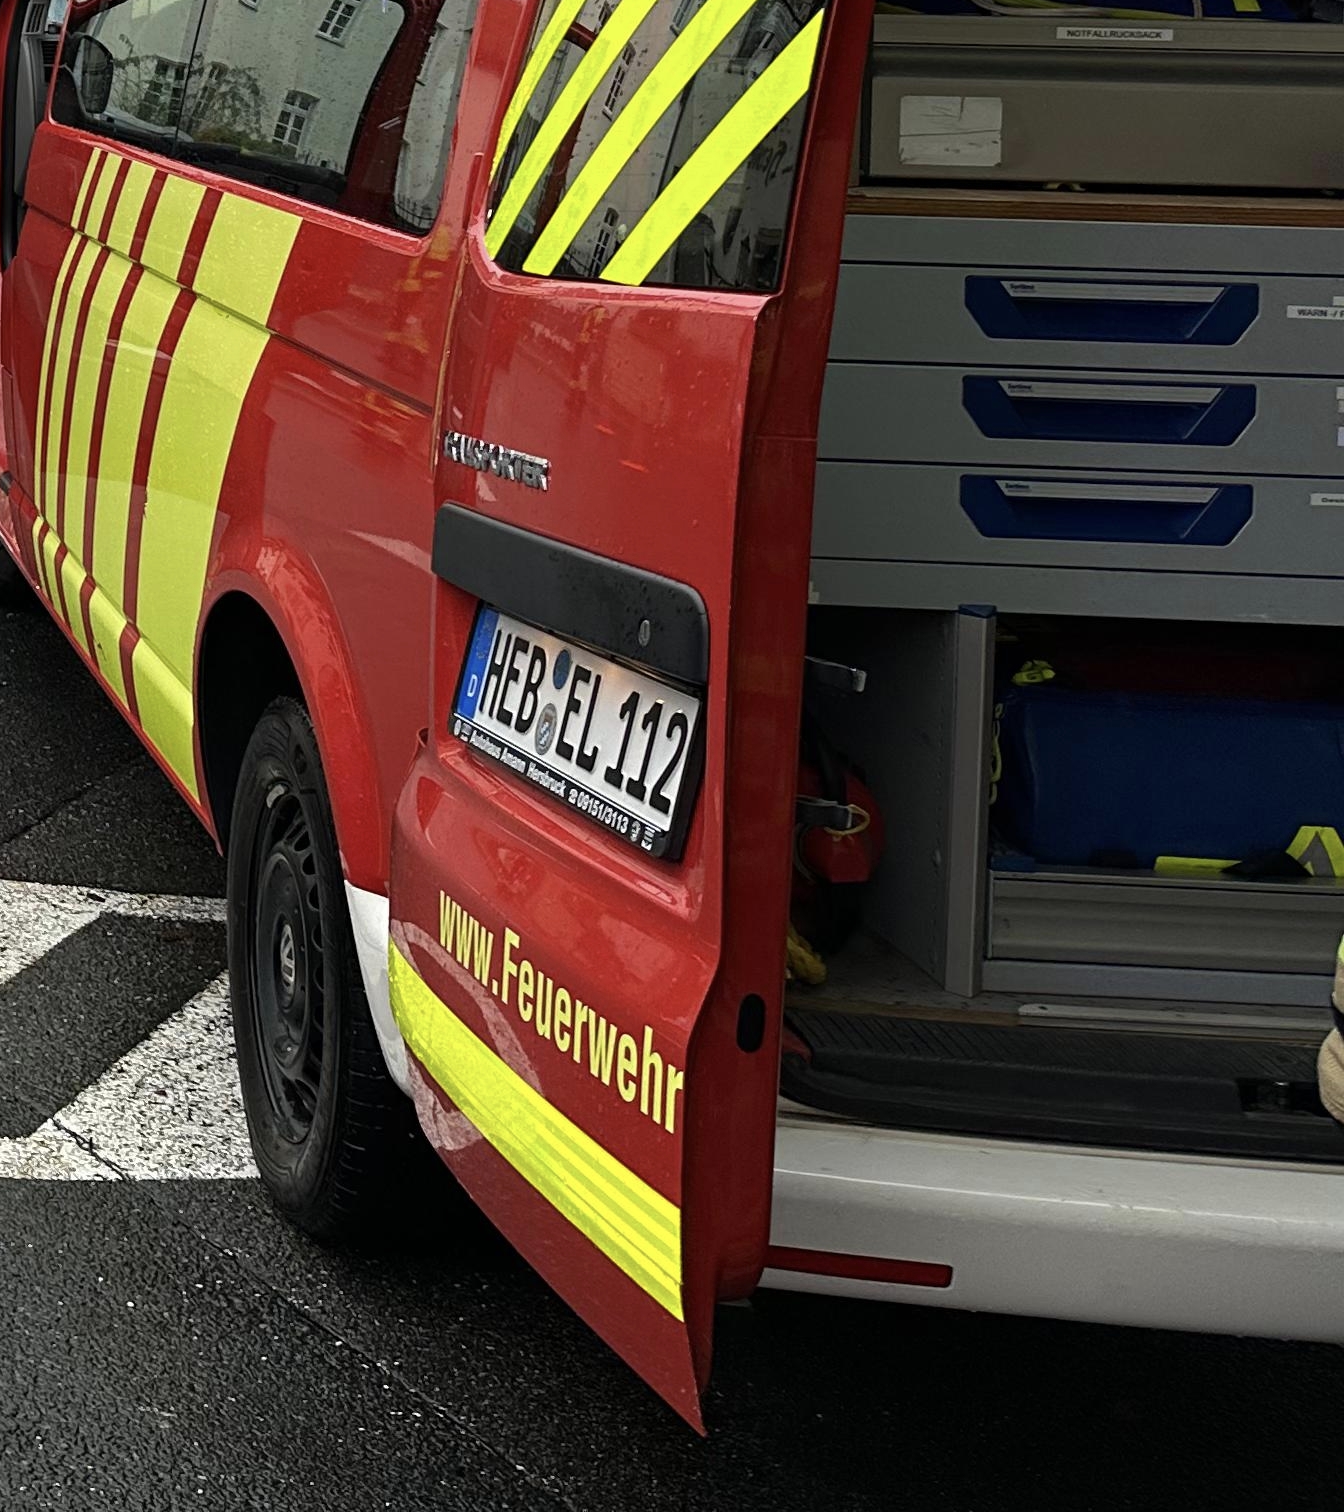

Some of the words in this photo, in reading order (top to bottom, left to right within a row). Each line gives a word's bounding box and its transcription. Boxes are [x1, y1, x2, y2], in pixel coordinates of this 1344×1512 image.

[1066, 29, 1162, 39] NOTFALLRUCKSACK
[479, 629, 547, 734] HEB
[555, 664, 602, 773] EL
[604, 691, 689, 815] 112
[526, 761, 567, 798] Hersbruck
[577, 791, 629, 834] 09151/3113
[439, 889, 684, 1135] www.Feuerwehr
